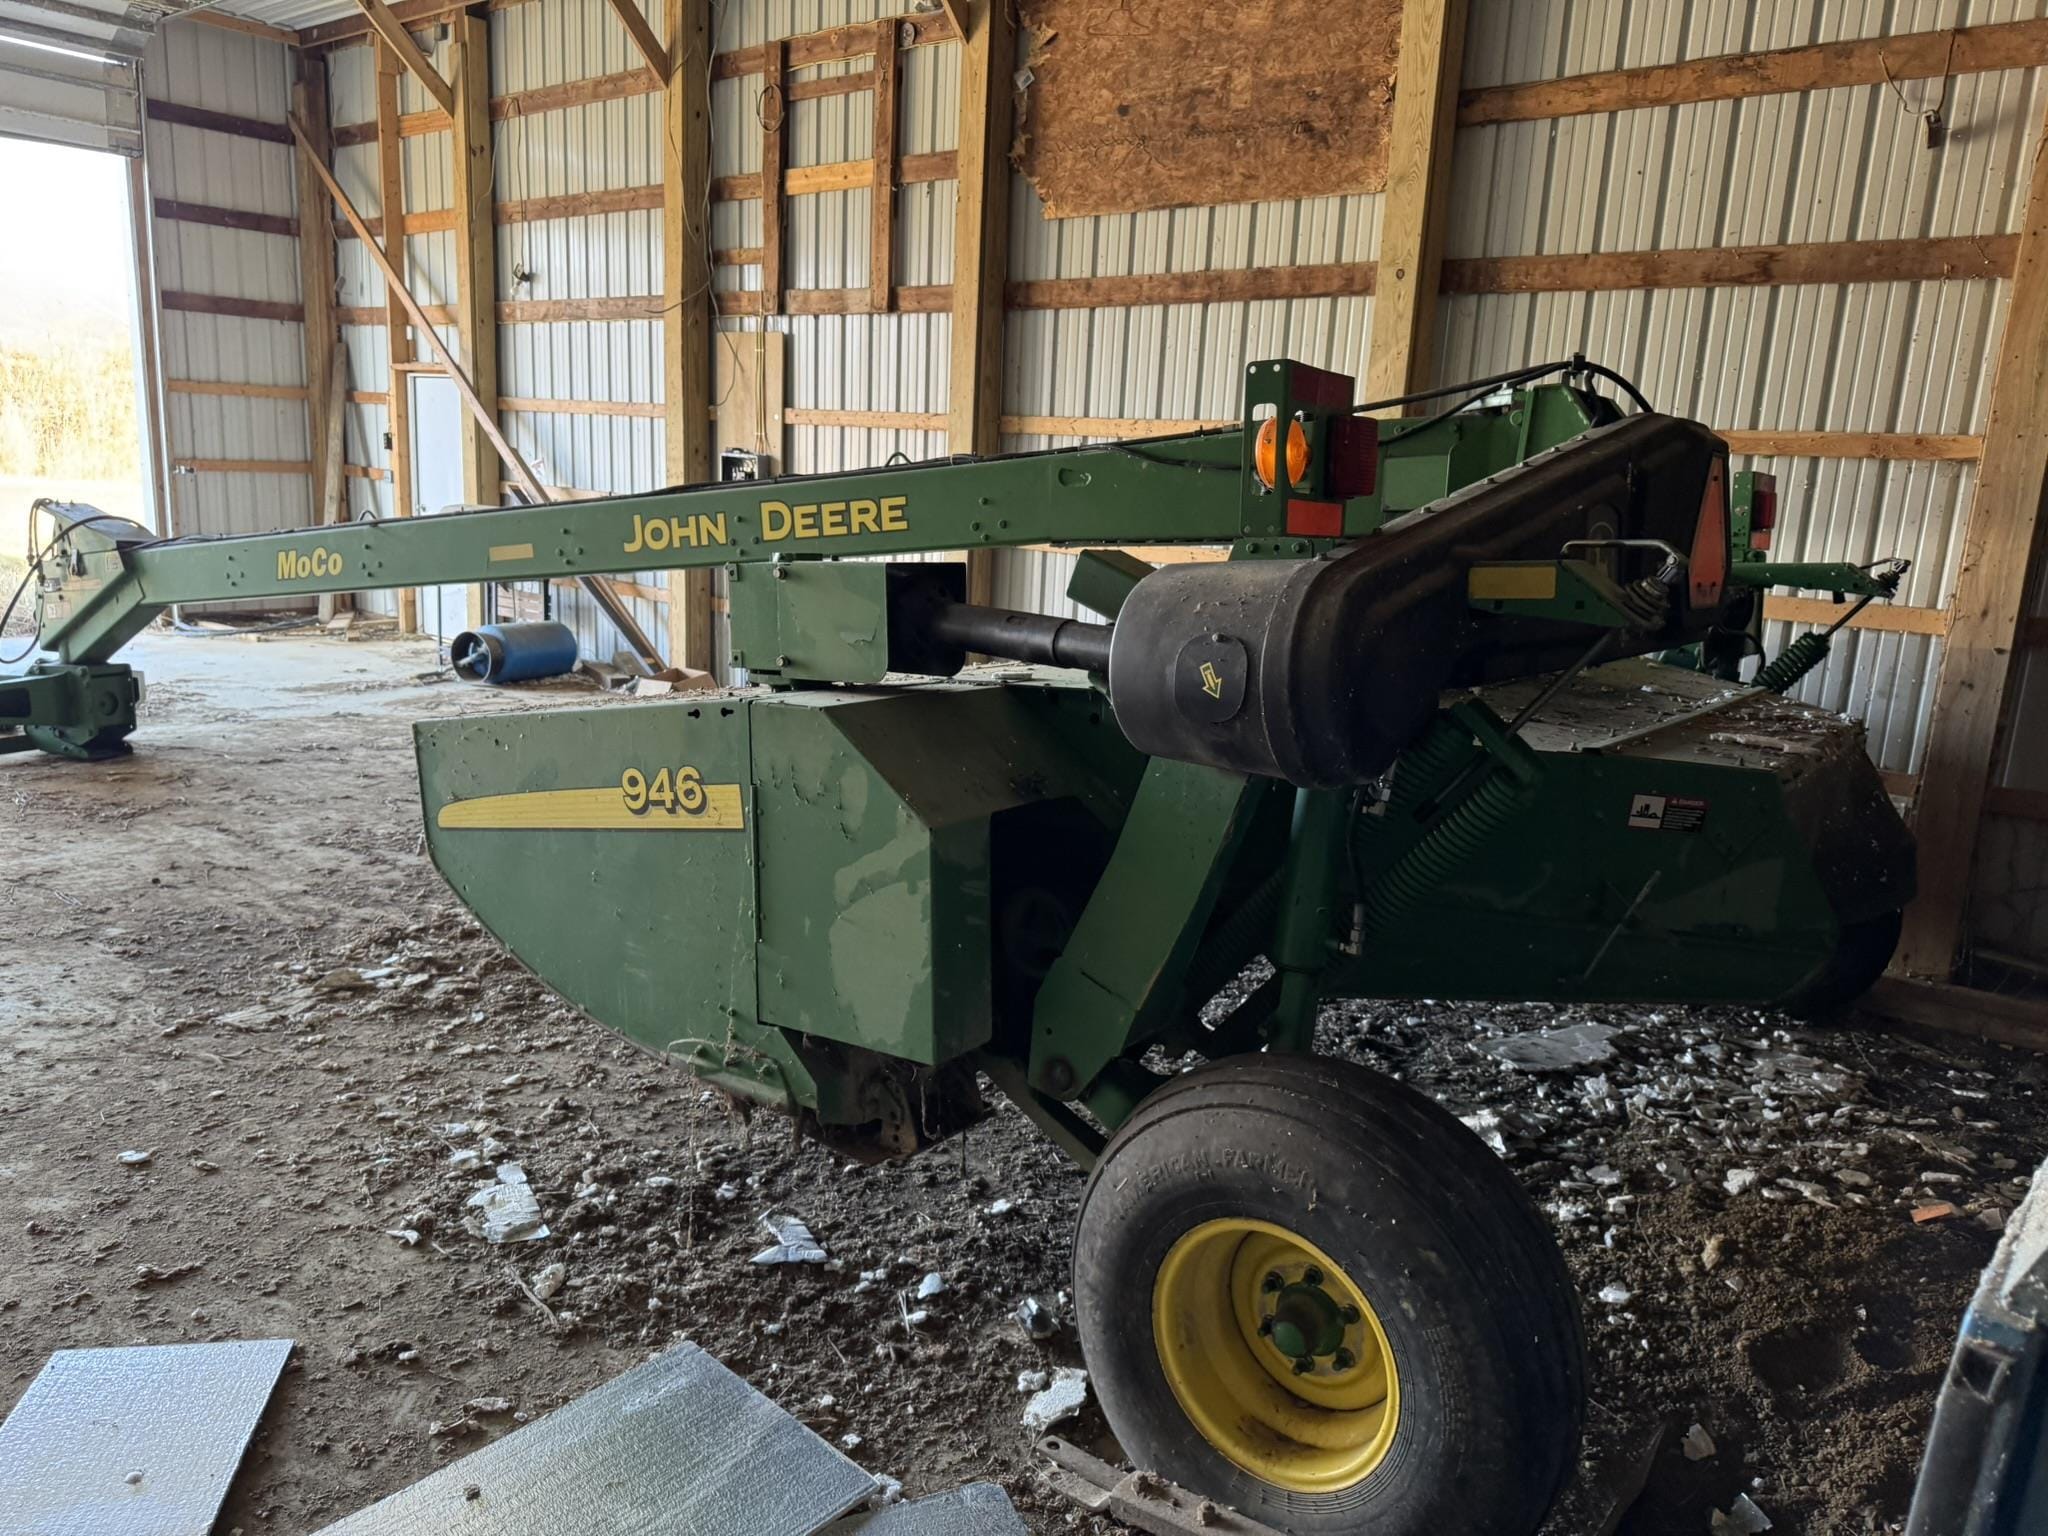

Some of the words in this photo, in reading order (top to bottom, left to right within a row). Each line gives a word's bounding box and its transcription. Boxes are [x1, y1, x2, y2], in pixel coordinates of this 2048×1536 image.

[623, 512, 728, 553] JOHN
[760, 495, 909, 542] DEERE
[277, 546, 343, 580] MoCo
[621, 765, 708, 816] 946
